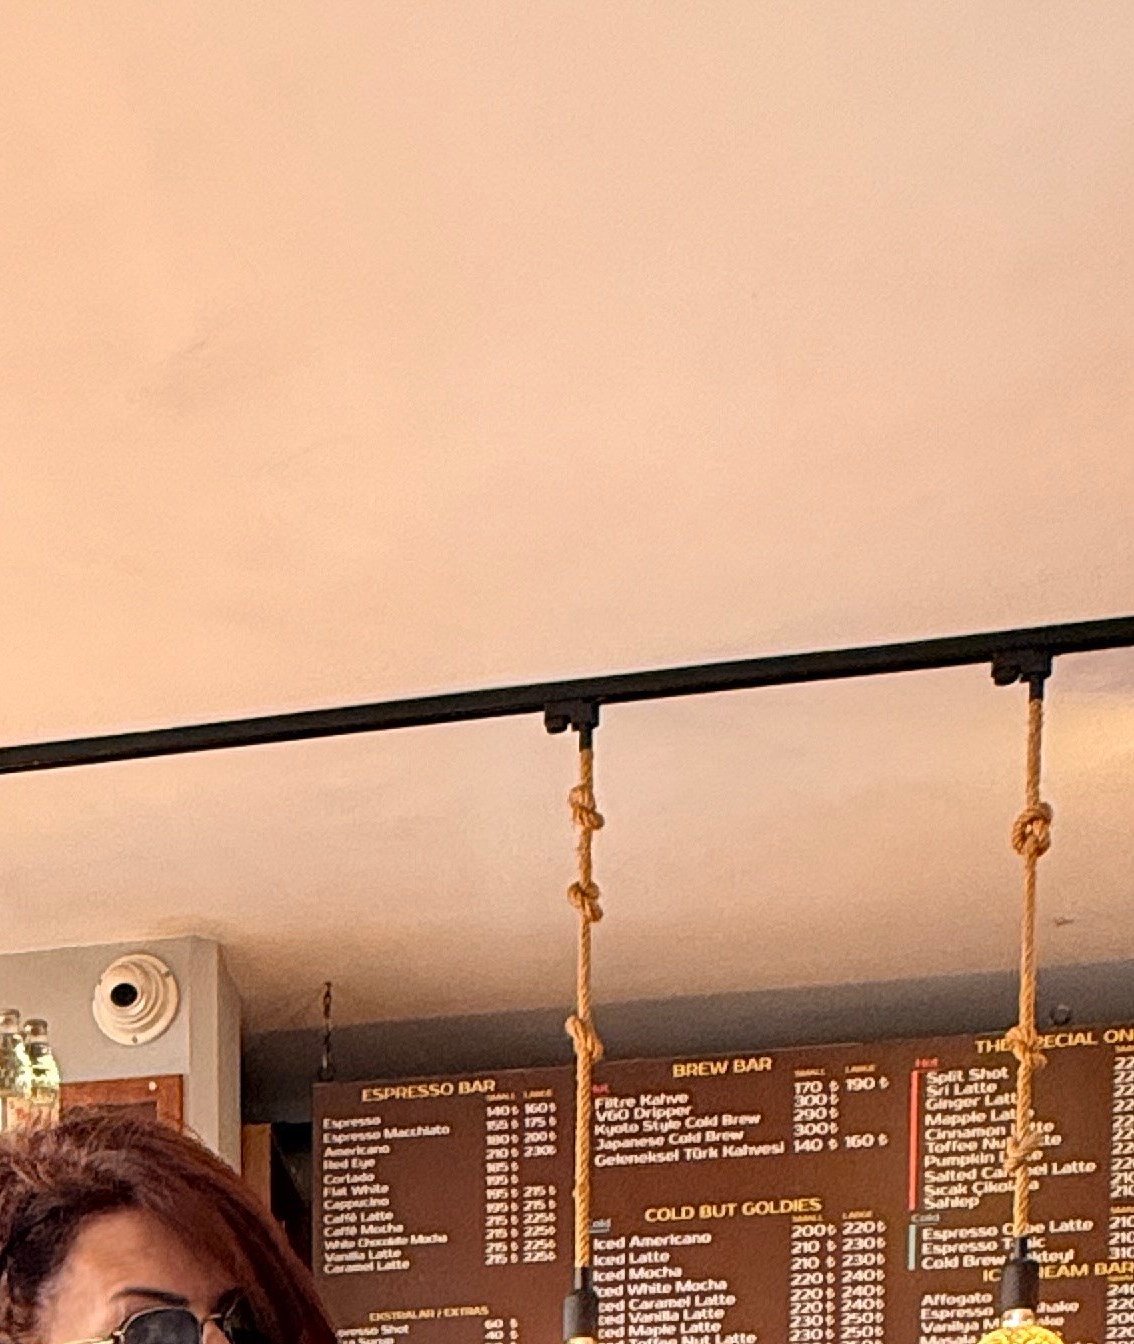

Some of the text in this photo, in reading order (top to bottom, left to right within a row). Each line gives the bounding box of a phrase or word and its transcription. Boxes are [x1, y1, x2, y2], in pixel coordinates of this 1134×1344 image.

[1033, 1032, 1098, 1049] ECIAL
[673, 1056, 773, 1078] BREW BAR
[845, 1076, 876, 1092] 190
[926, 1067, 1009, 1086] Split Shot
[362, 1079, 496, 1102] ESPRESSO BAR
[794, 1080, 823, 1094] 170
[954, 1082, 998, 1096] Latte
[595, 1092, 689, 1110] Filtre Kahve
[926, 1092, 1017, 1112] Ginger Latt
[633, 1105, 692, 1120] Dripper
[925, 1108, 1036, 1127] Mapple Late
[323, 1116, 381, 1130] Espresso
[595, 1113, 761, 1138] Kyoto Style Cold Brew
[925, 1120, 1055, 1141] Cinnamon Ltte
[323, 1124, 450, 1144] Espresso Macchiato
[524, 1131, 548, 1143] 200
[596, 1129, 745, 1152] Japanese Cold Brew
[845, 1134, 875, 1149] 160
[324, 1145, 390, 1157] Americano
[793, 1138, 823, 1153] 140
[926, 1137, 1007, 1154] Toffee Nu
[595, 1140, 785, 1168] Geleneksel Türk Kahvesi
[925, 1151, 996, 1168] Pumpkin
[323, 1173, 375, 1184] Cortado
[925, 1160, 1098, 1184] Salted Latte
[323, 1183, 389, 1198] Flat White
[925, 1182, 968, 1197] Sıcak
[645, 1198, 823, 1222] COLD BUT GOLDIES
[924, 1195, 980, 1210] Sahlep
[361, 1211, 394, 1223] Latte
[361, 1223, 404, 1235] Mocha
[922, 1218, 1094, 1242] Espresso Latte
[593, 1233, 712, 1250] Iced Americano
[791, 1240, 820, 1255] 210
[922, 1240, 998, 1256] Espresso
[369, 1249, 402, 1260] Latte
[593, 1250, 670, 1266] Iced Latte
[921, 1254, 1008, 1271] Cold Brew
[377, 1260, 410, 1271] Latte
[791, 1256, 820, 1271] 210
[593, 1266, 682, 1282] Iced Mocha
[1039, 1264, 1089, 1280] EAM
[627, 1281, 672, 1296] White
[675, 1278, 728, 1293] Mocha
[599, 1294, 737, 1313] ced Caramel Latte
[921, 1293, 993, 1308] Affogato
[598, 1307, 726, 1326] ced Vanilla Latte
[921, 1306, 995, 1321] Espresso
[598, 1321, 722, 1340] ced Maple Latte
[921, 1320, 980, 1335] Vanilya
